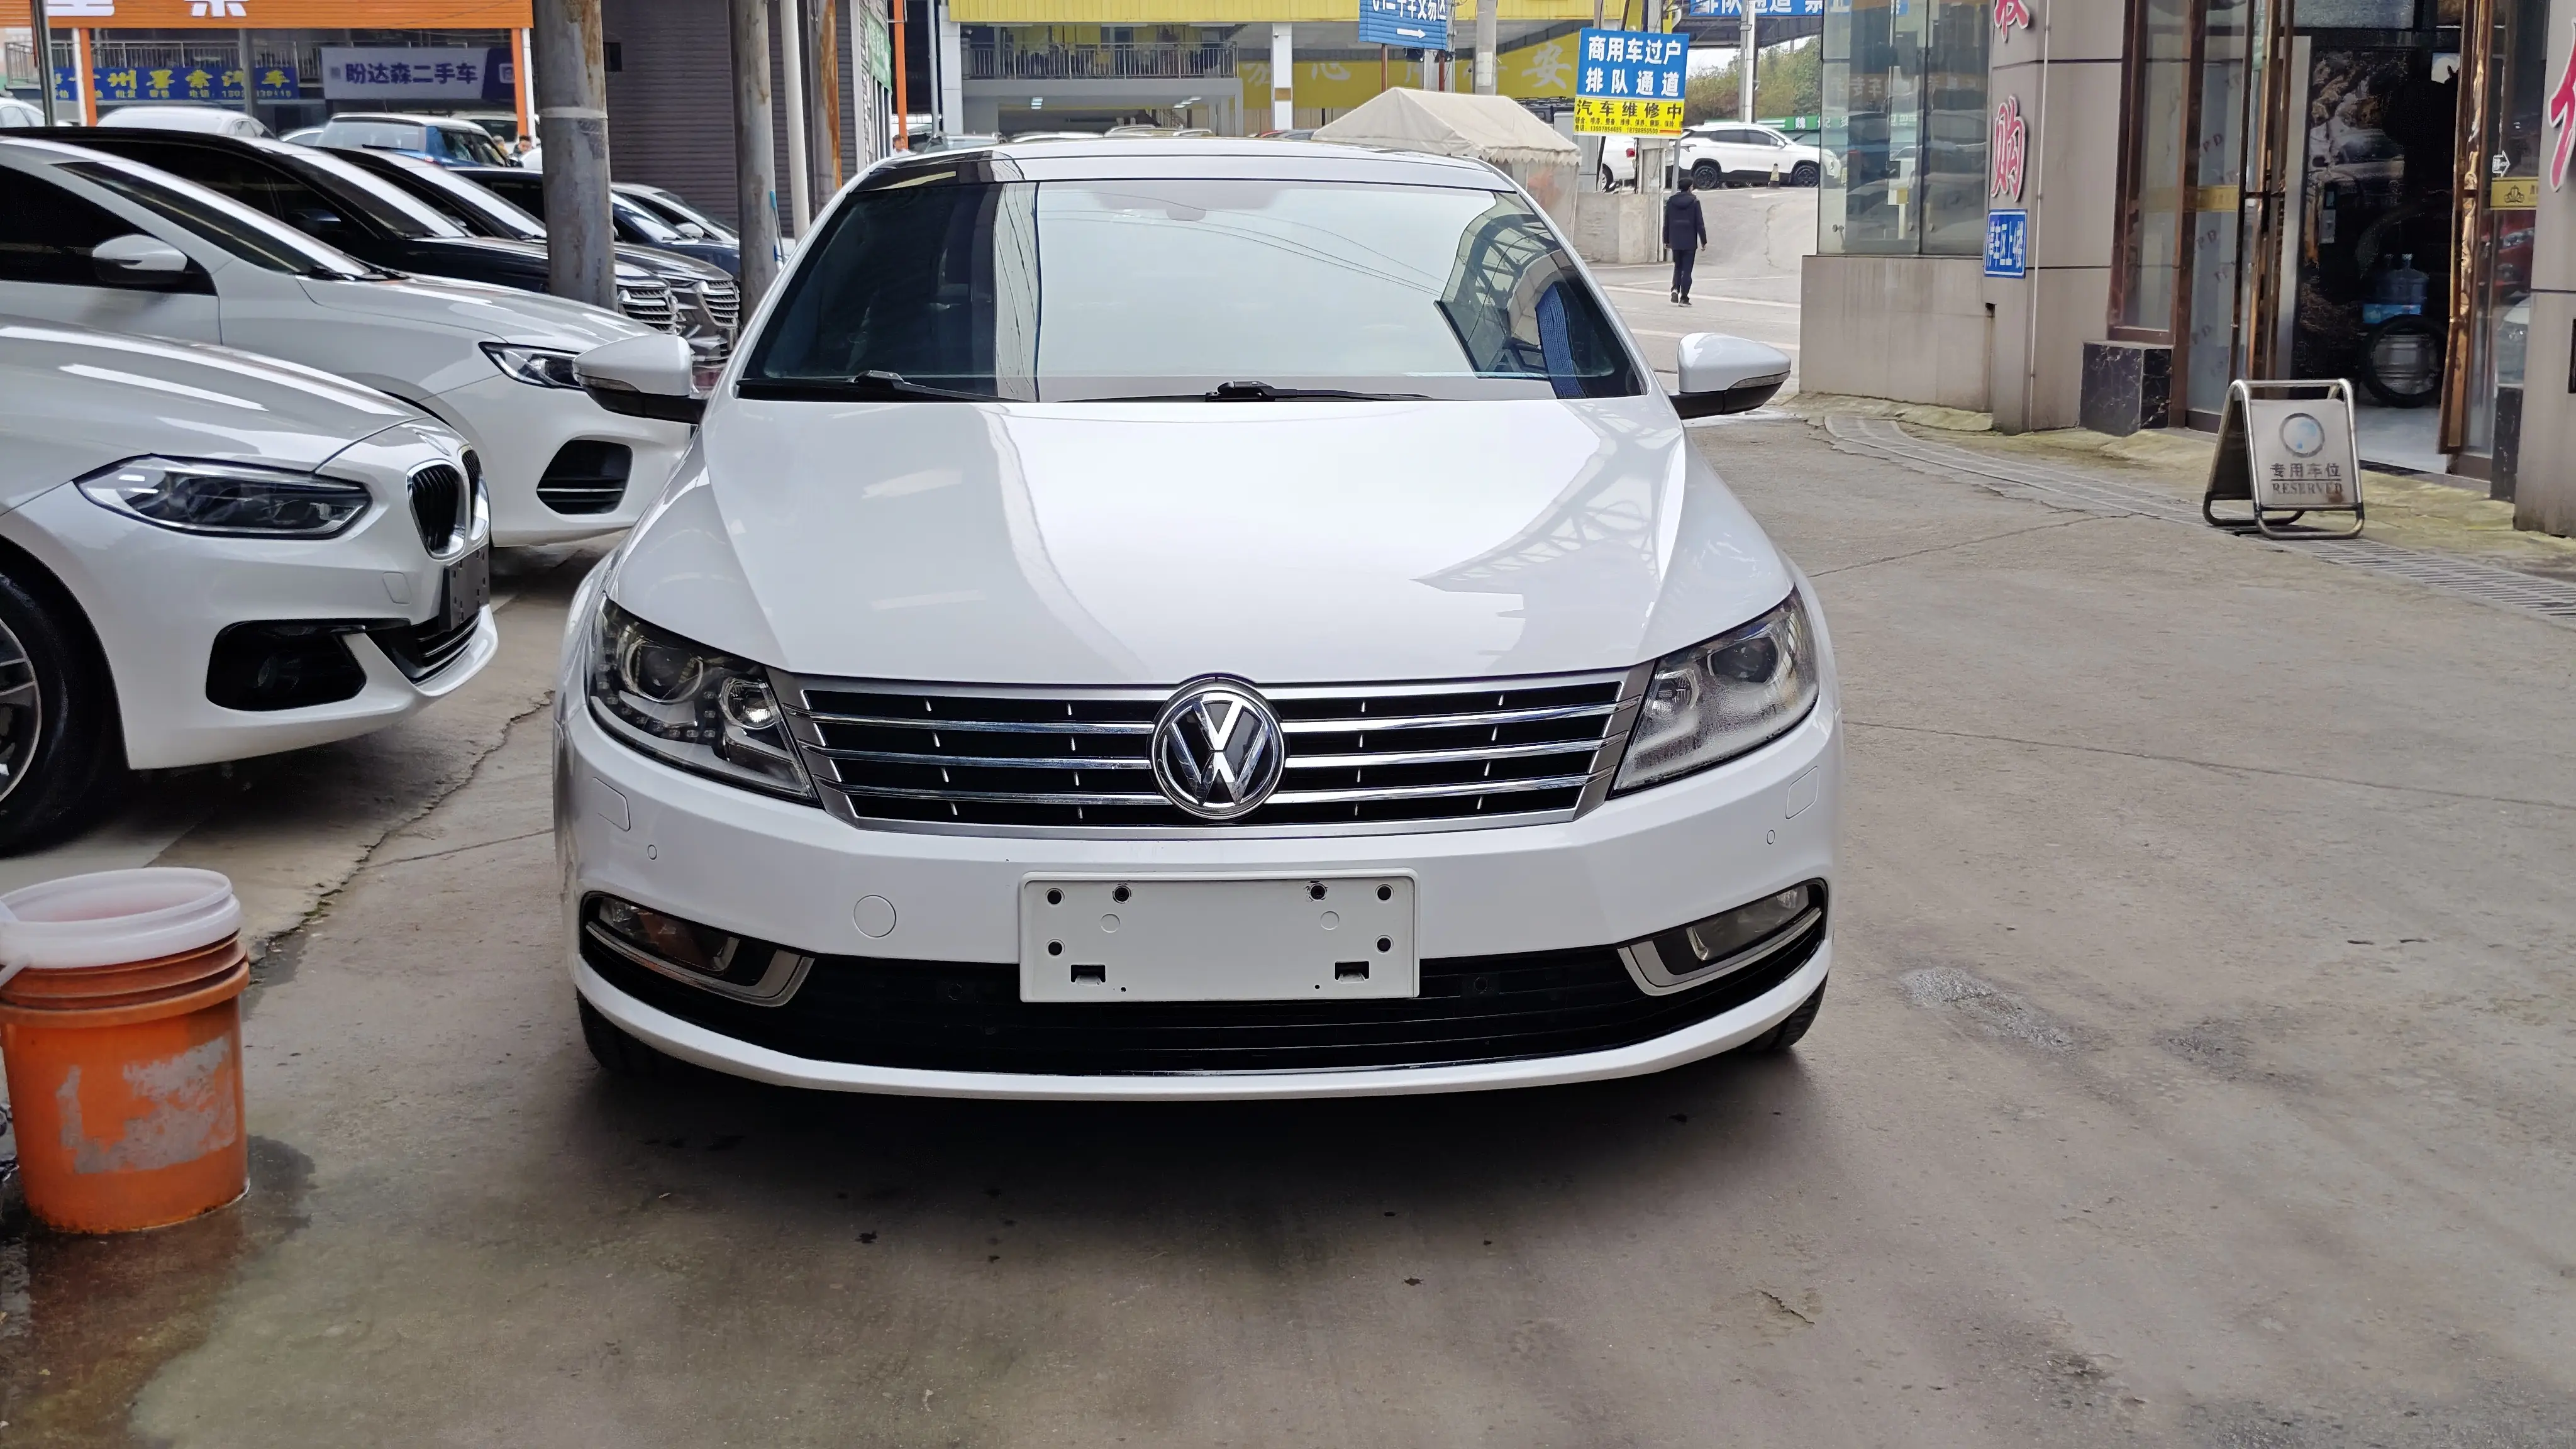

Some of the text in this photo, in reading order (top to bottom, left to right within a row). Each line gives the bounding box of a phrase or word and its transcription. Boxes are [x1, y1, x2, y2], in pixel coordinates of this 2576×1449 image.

[1589, 35, 1681, 65] 商用车过户
[1585, 67, 1679, 96] 排队通道
[1577, 99, 1682, 119] 汽车维修中
[2270, 463, 2341, 478] 专用车位
[2272, 483, 2343, 495] RESERVED
